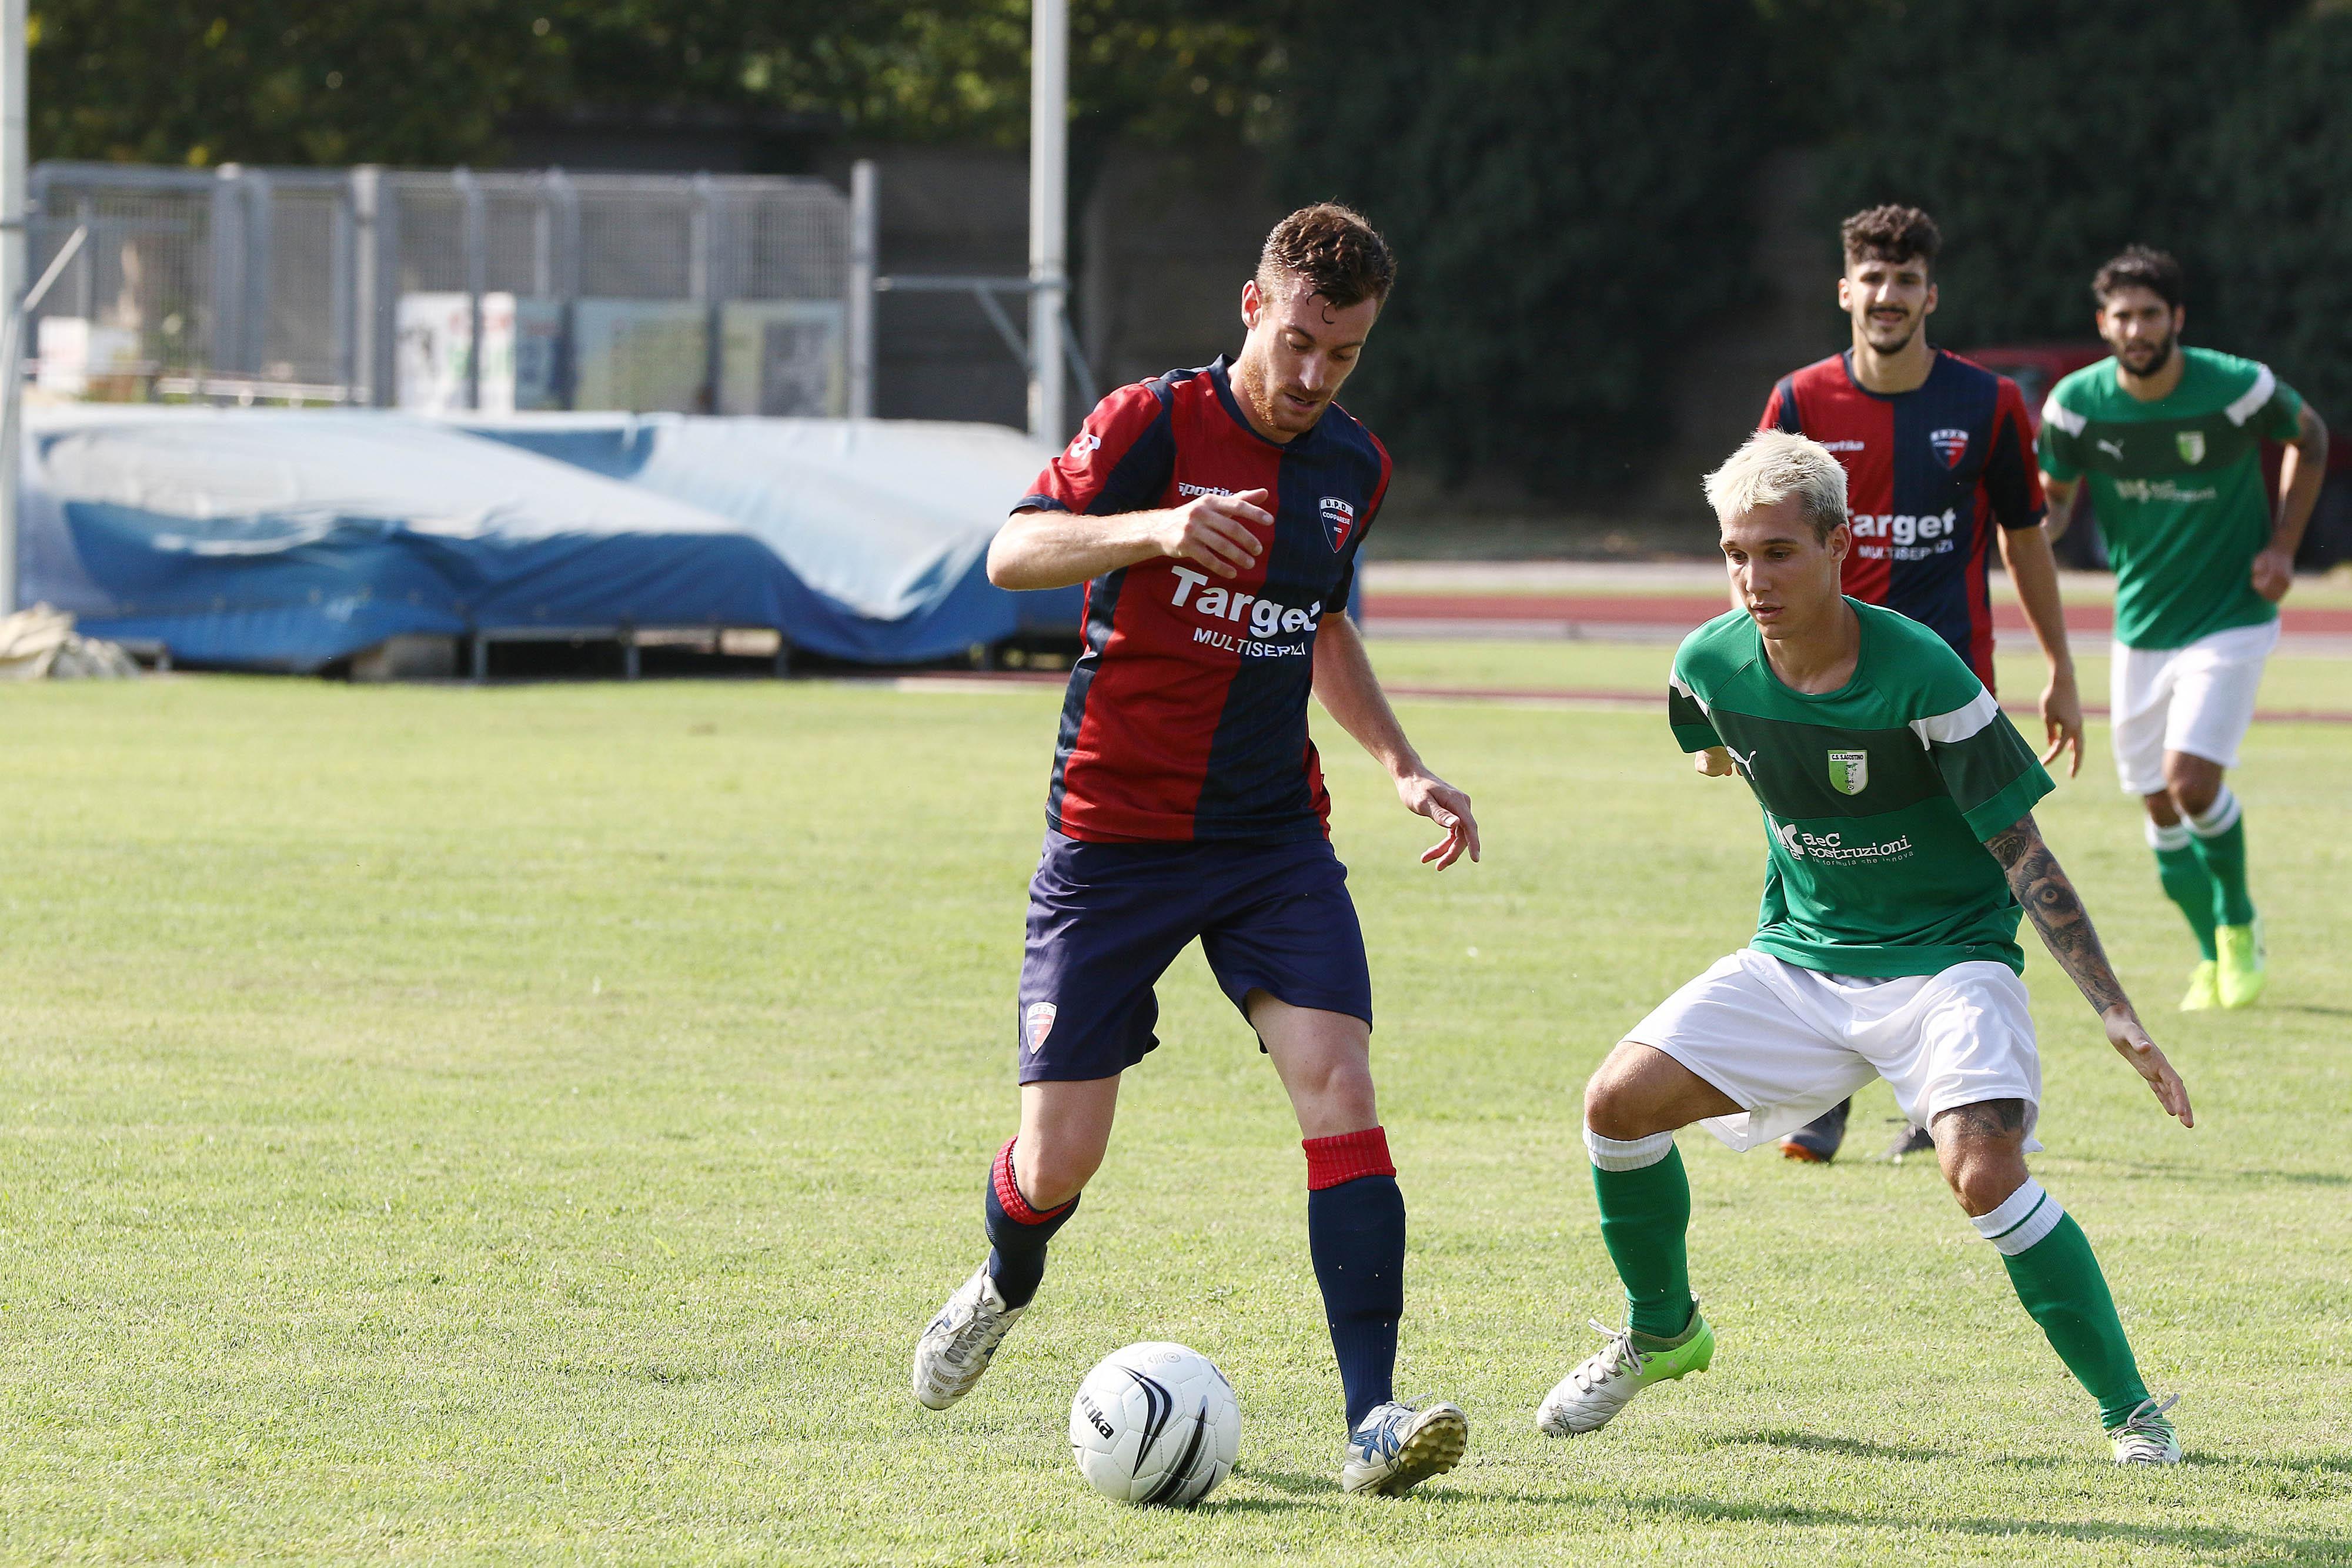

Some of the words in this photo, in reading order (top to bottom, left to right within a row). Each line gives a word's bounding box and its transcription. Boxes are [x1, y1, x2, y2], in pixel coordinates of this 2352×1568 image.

[1178, 482, 1234, 497] sportik
[1322, 511, 1351, 526] COPPARESE
[1847, 507, 1957, 546] arget
[1171, 565, 1321, 638] Target
[1807, 835, 1912, 860] costruzioni
